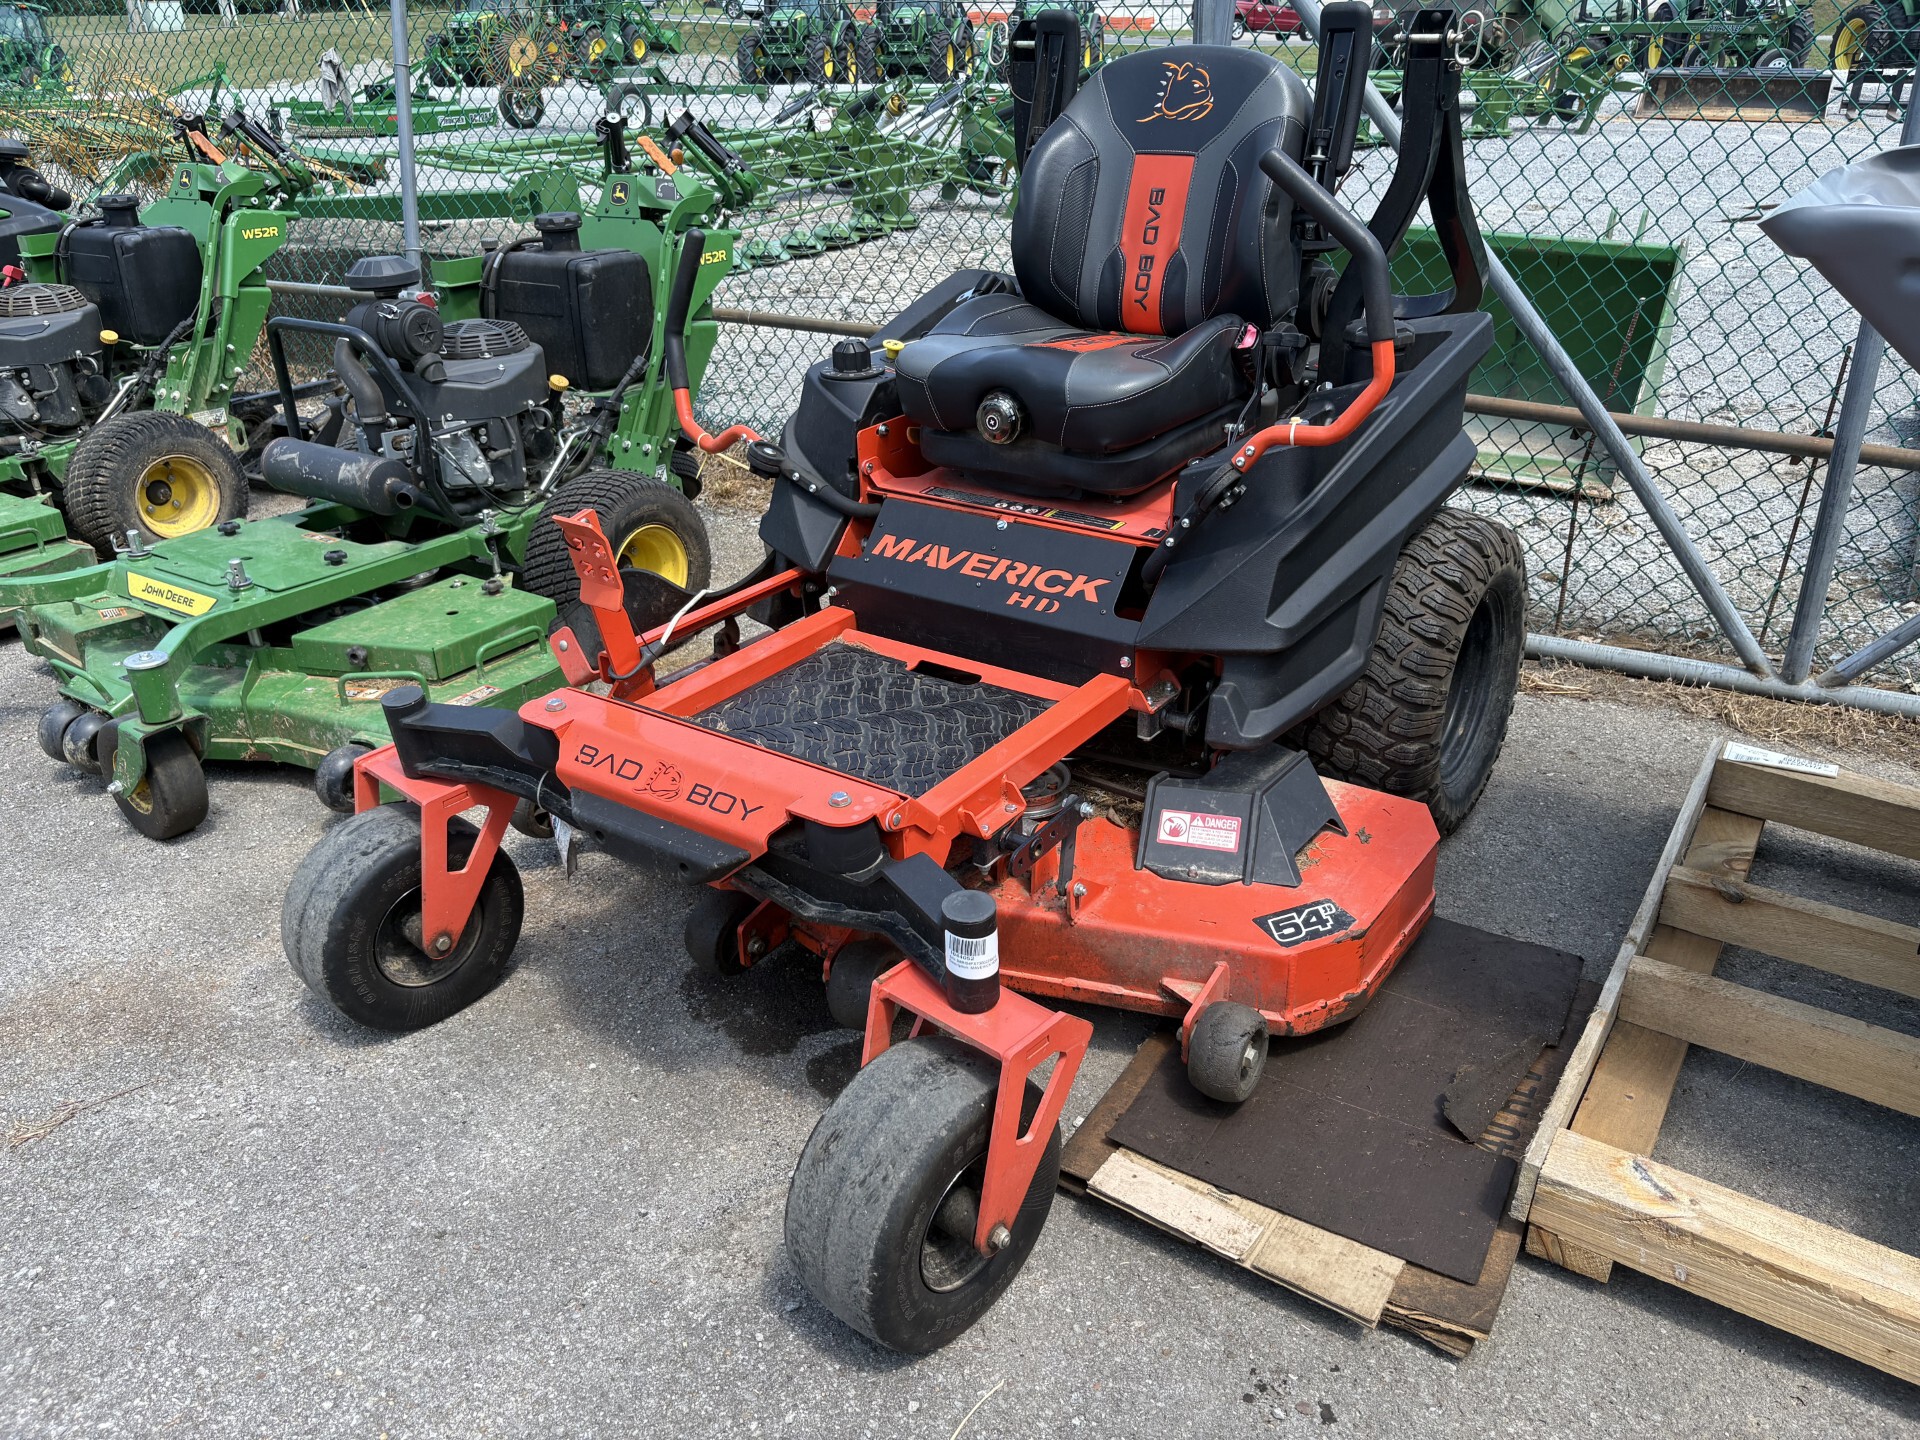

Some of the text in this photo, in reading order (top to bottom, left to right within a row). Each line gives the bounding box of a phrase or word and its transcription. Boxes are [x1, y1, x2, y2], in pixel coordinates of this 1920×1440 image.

[241, 226, 279, 240] W52R
[1133, 187, 1166, 312] BAD BOY
[871, 533, 1113, 603] MAVERICK
[141, 582, 196, 608] JOHN DEERE
[1006, 591, 1061, 614] HD
[575, 743, 765, 822] BAD BOY
[1204, 816, 1238, 831] DANGER
